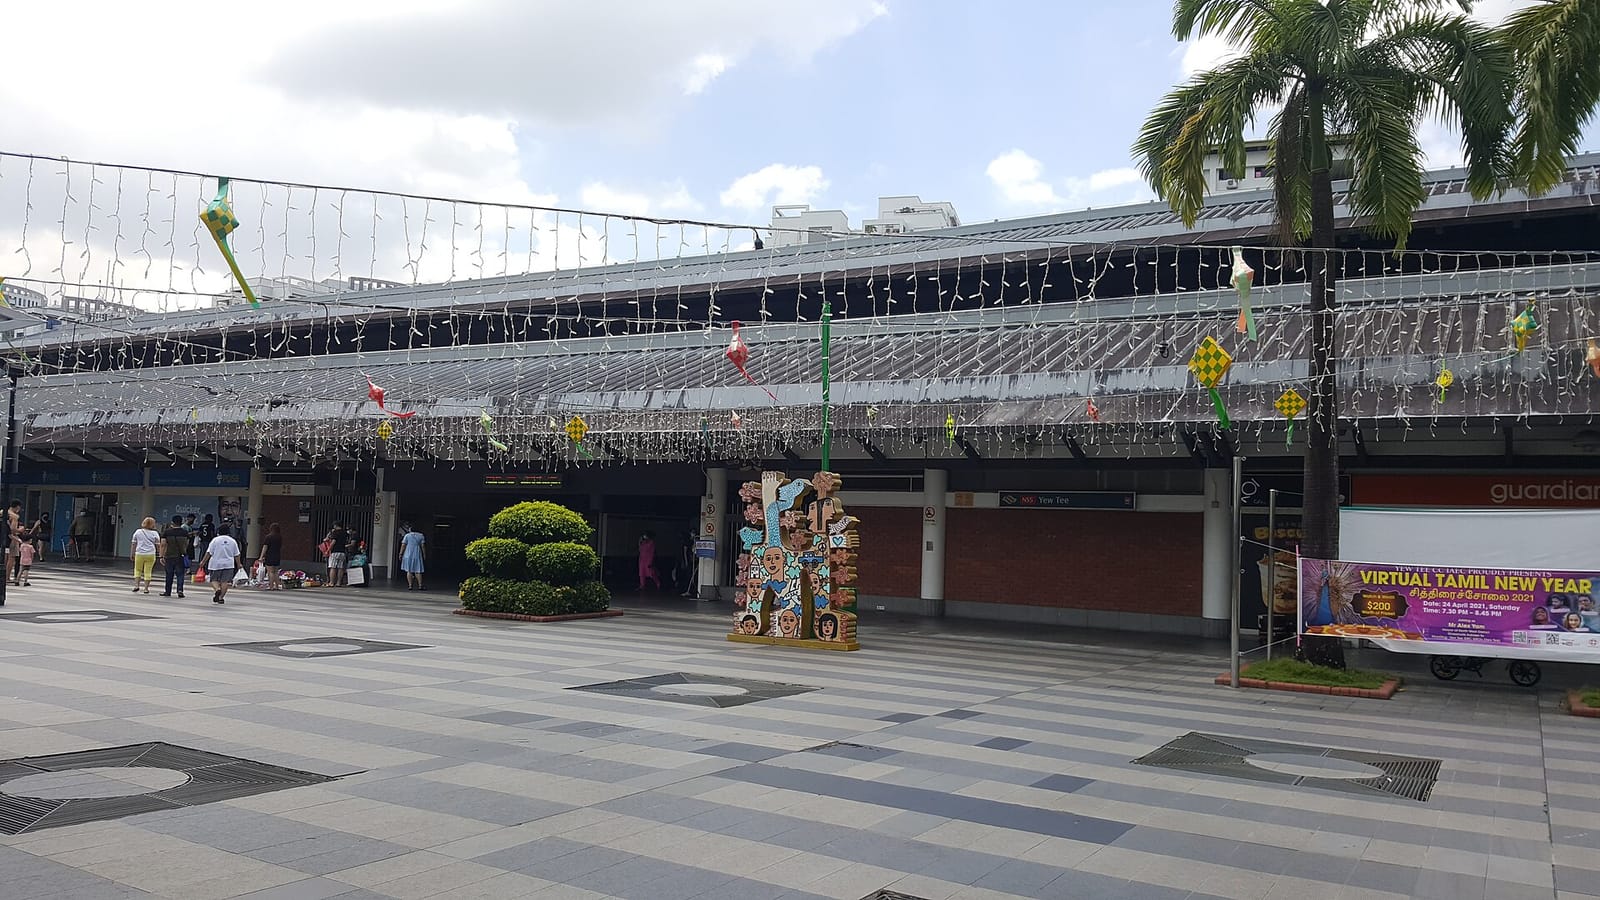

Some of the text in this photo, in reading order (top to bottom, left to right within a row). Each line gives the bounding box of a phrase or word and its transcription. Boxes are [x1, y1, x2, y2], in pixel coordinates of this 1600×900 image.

[1038, 496, 1053, 504] Yew
[1056, 496, 1069, 504] Tee
[1468, 568, 1506, 576] PROUDLY
[1360, 570, 1592, 594] VIRTUAL TAMIL NEW YEAR
[1512, 593, 1534, 602] 2021
[1367, 601, 1391, 611] $200
[1452, 601, 1468, 609] April
[1469, 602, 1488, 610] 2021,
[1489, 603, 1520, 612] Saturday
